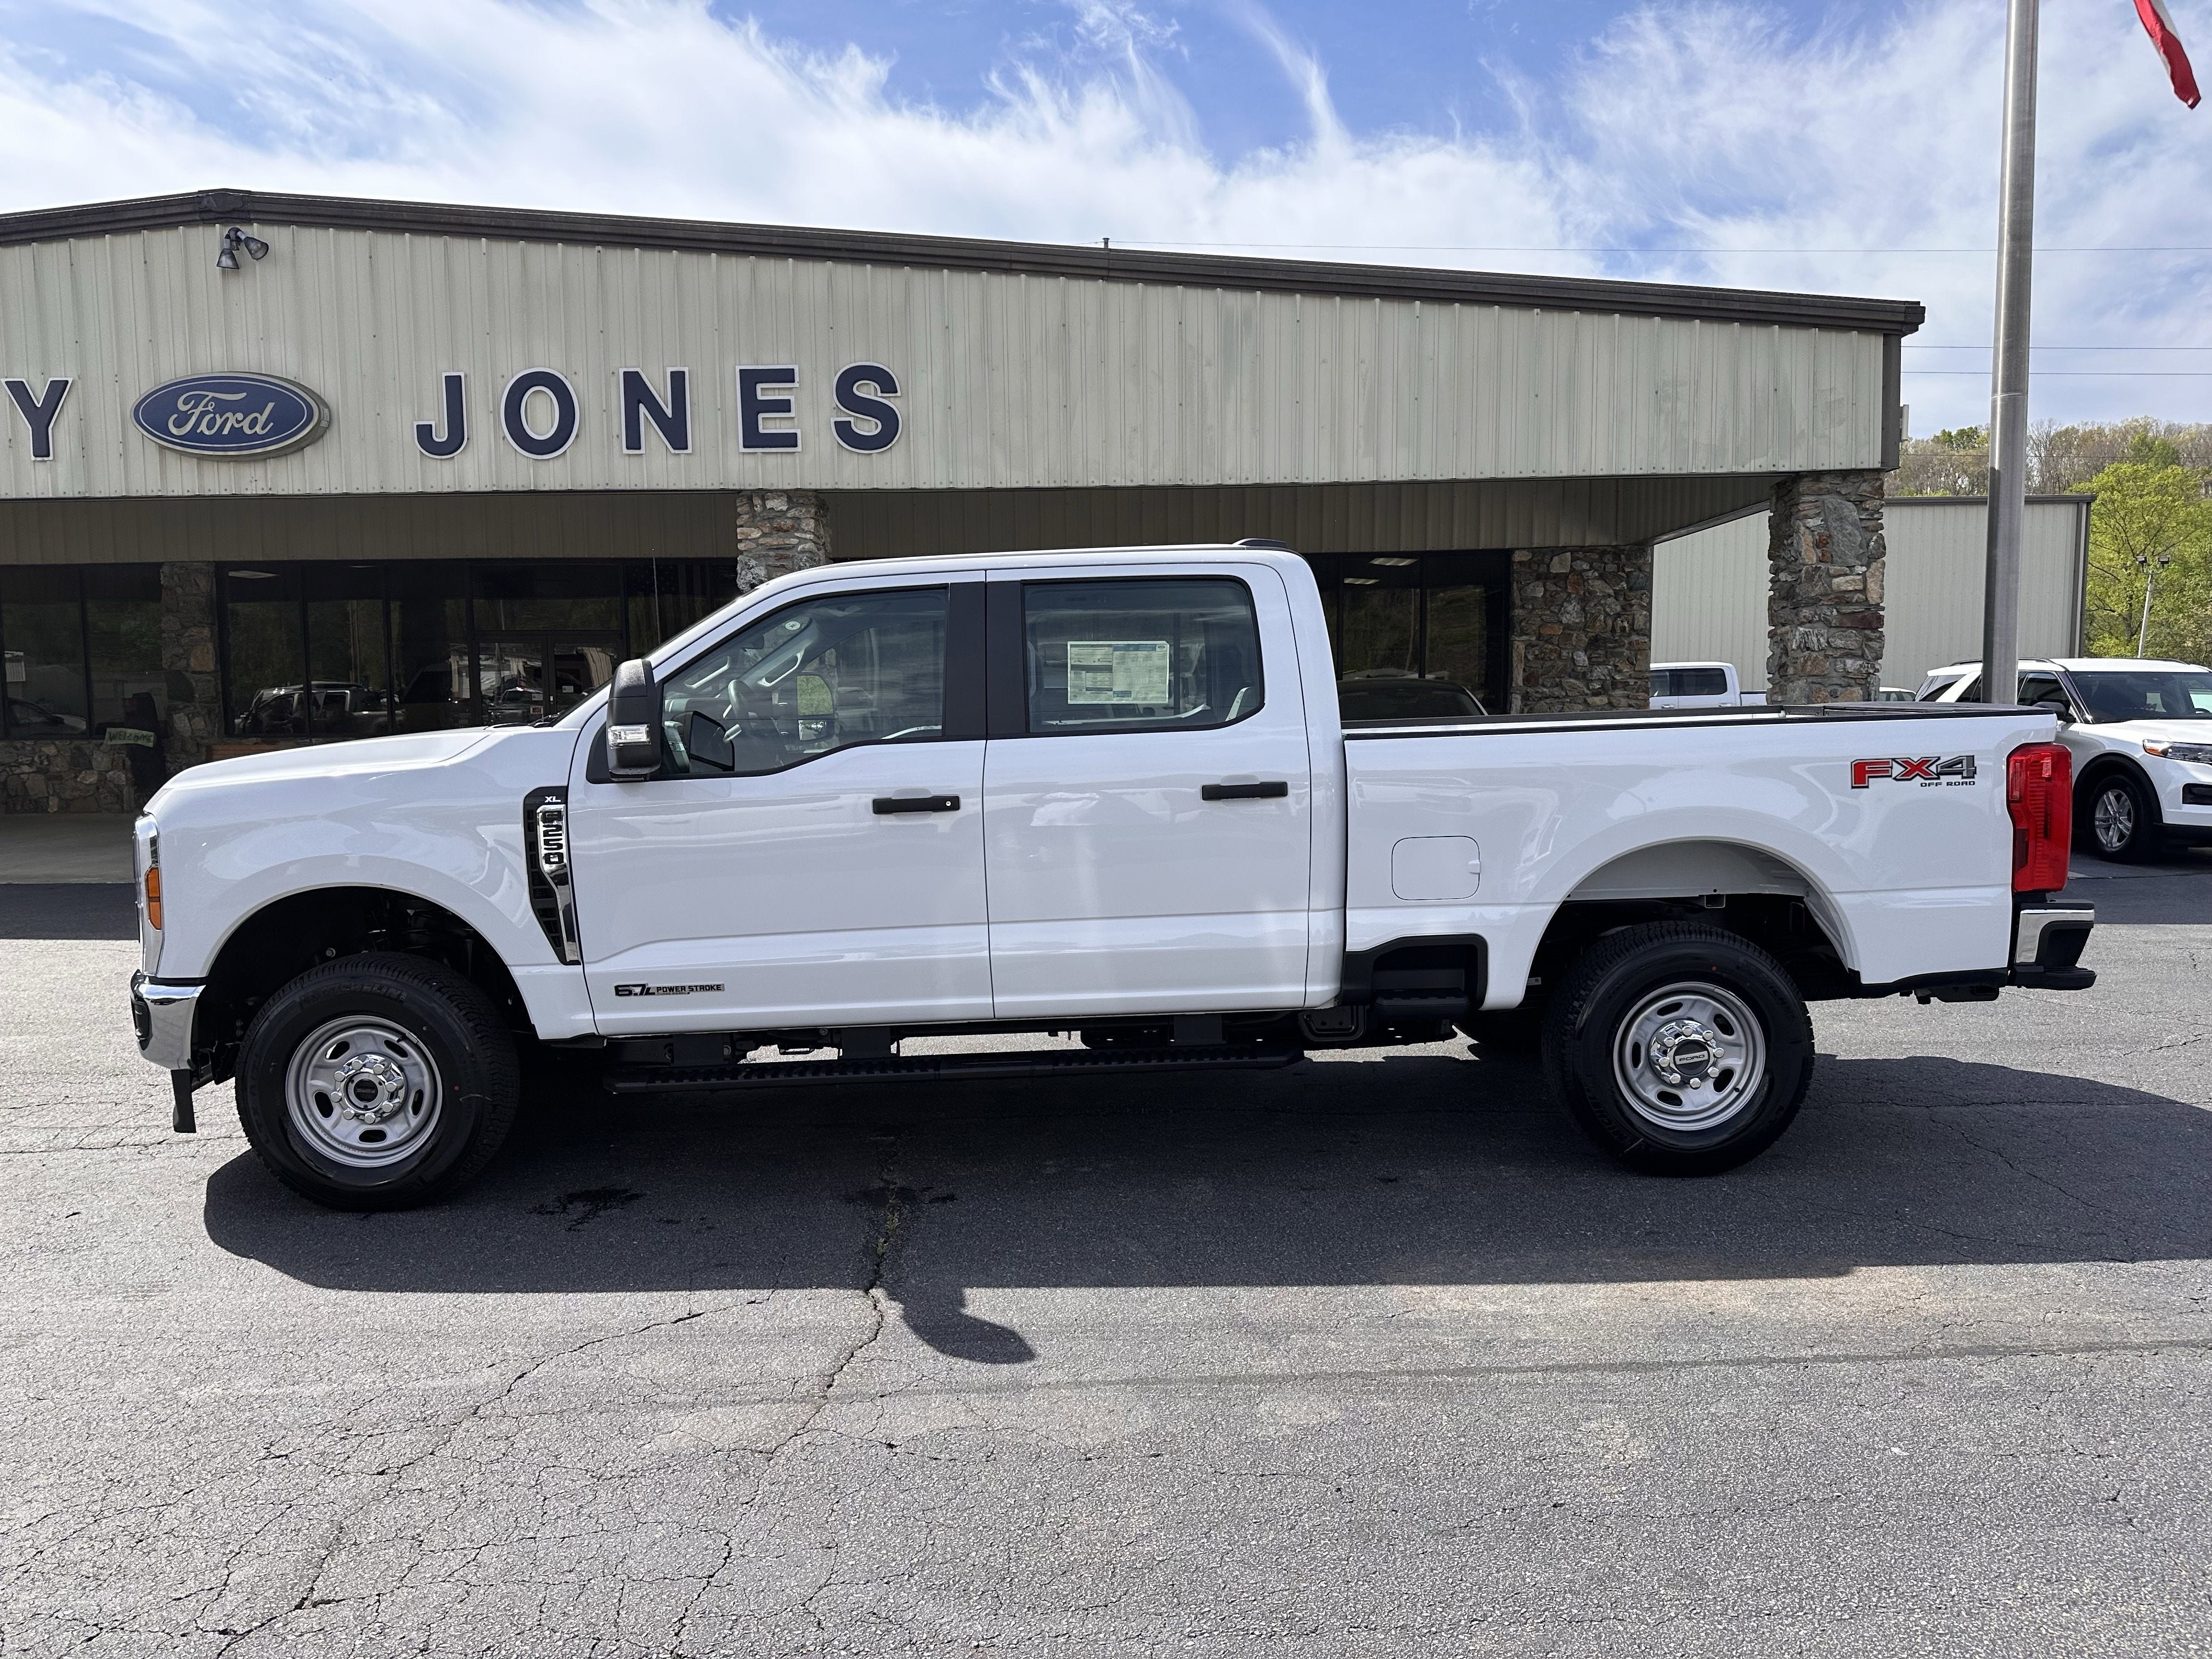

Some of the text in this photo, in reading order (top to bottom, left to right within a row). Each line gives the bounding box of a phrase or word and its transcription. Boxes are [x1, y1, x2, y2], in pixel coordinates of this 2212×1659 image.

[1, 362, 902, 461] Y JONES
[168, 391, 275, 436] Ford
[1850, 755, 1977, 789] FX4
[614, 983, 656, 996] 6.7L
